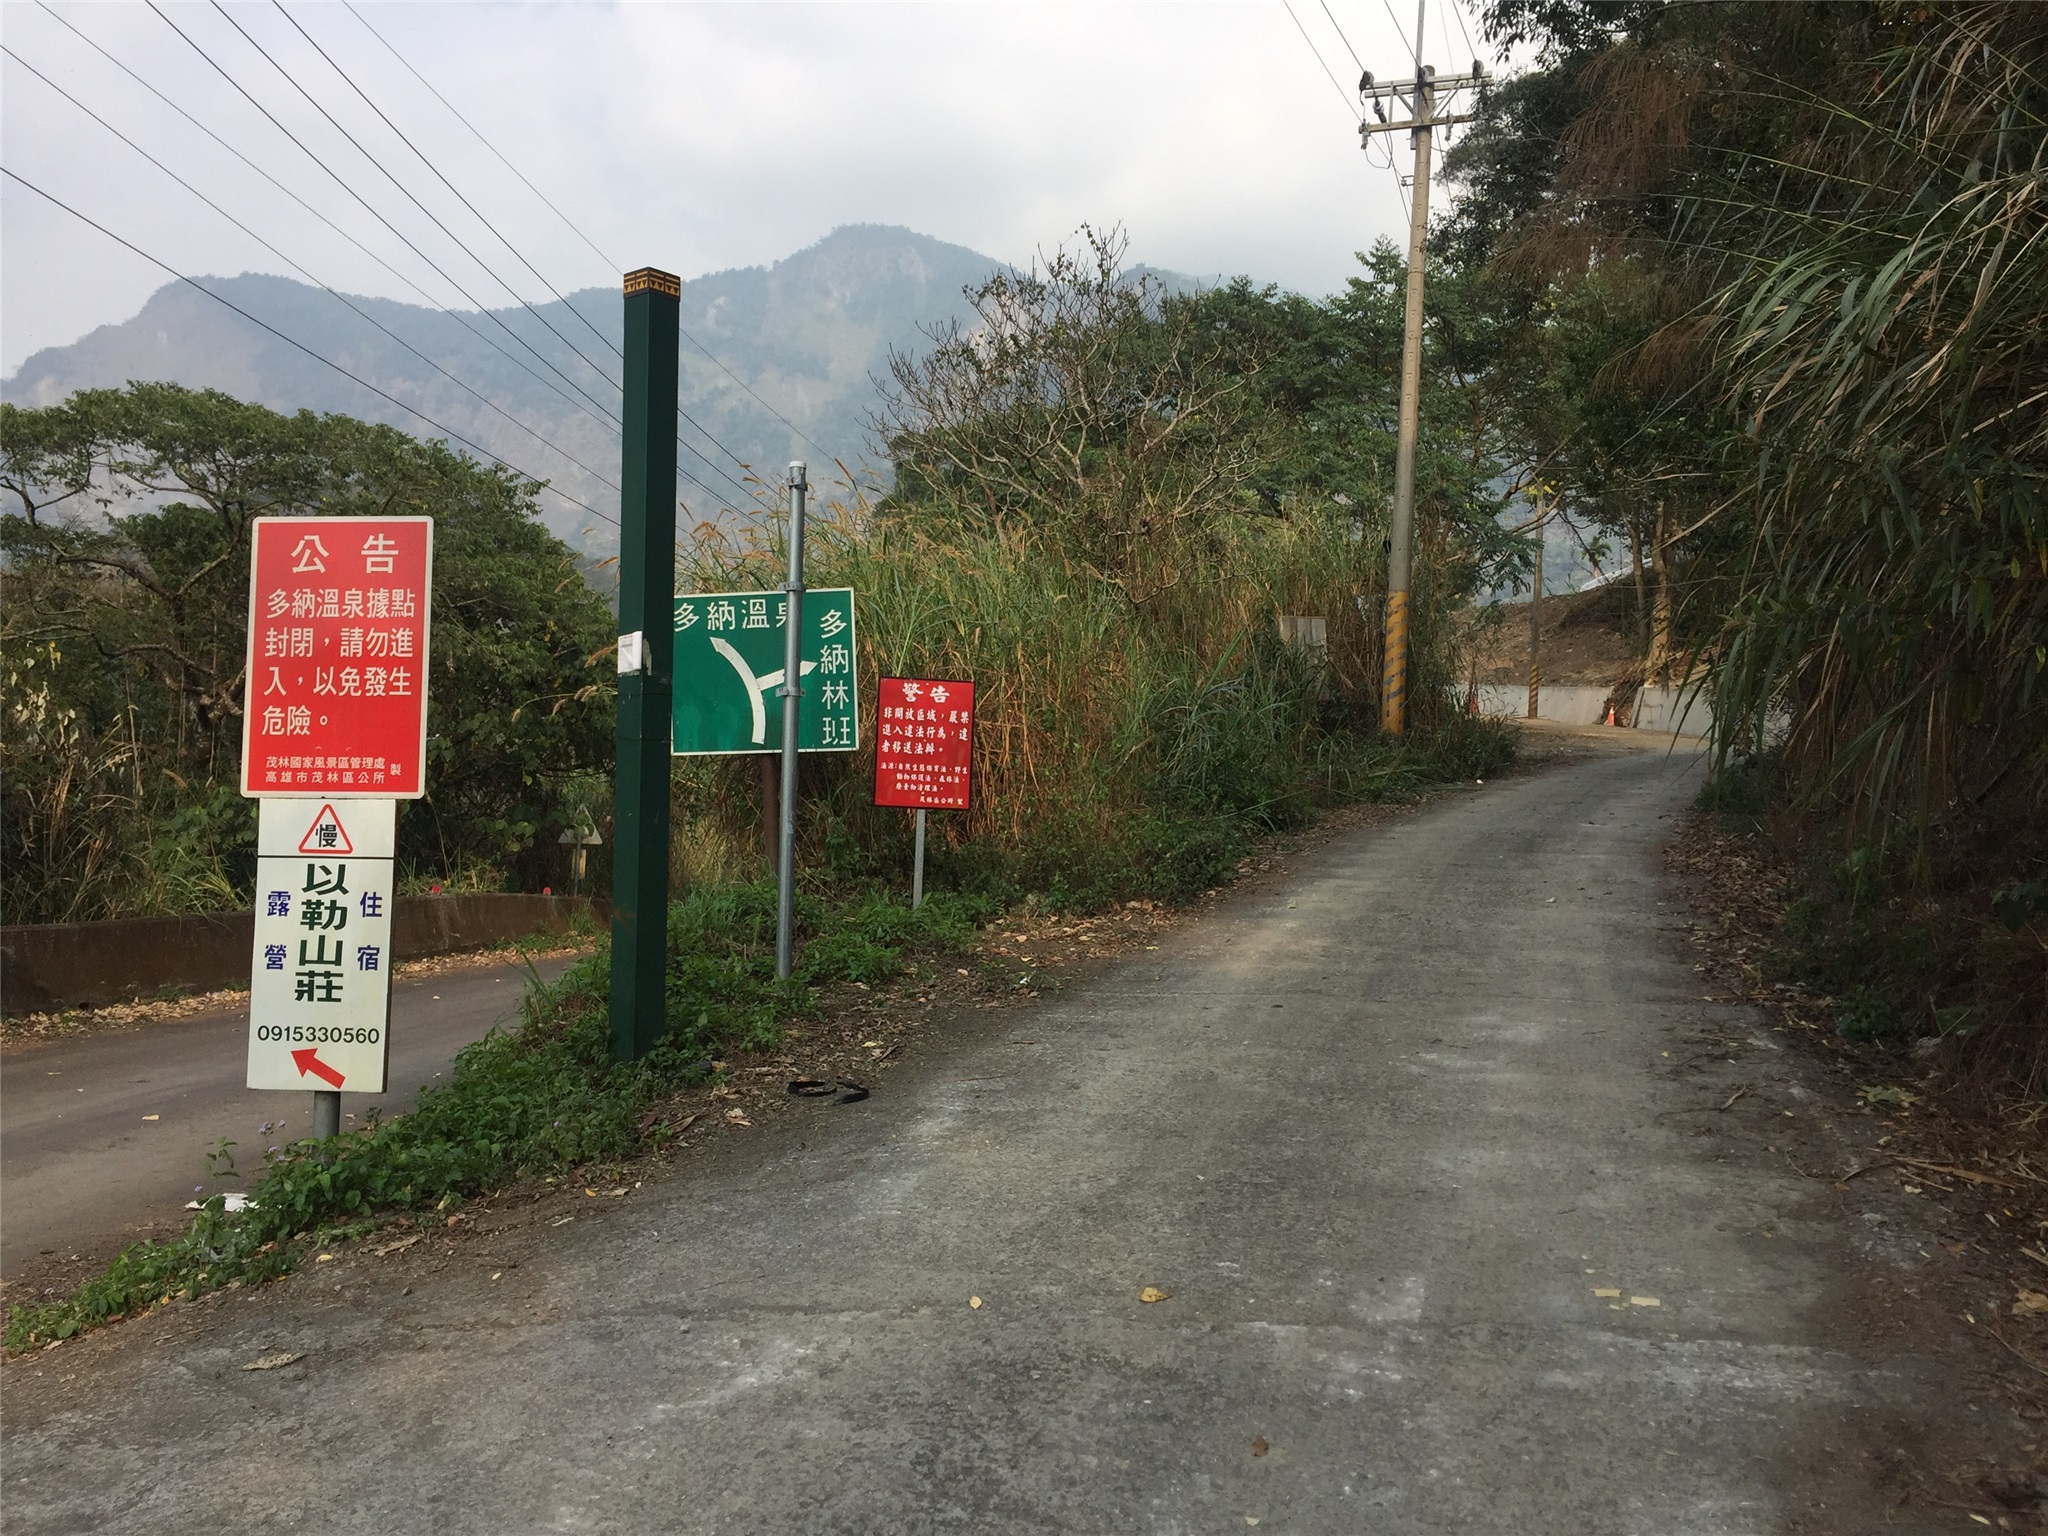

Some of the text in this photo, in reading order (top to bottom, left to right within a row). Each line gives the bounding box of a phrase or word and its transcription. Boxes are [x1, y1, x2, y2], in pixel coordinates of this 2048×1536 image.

[290, 533, 399, 574] 公告
[265, 588, 416, 619] 多納溫泉據點
[264, 627, 414, 658] 封閉，請勿進
[263, 666, 412, 697] 入，以免發生
[819, 608, 851, 746] 多納林班
[901, 682, 951, 704] 警告
[261, 705, 328, 737] 危險。
[265, 755, 402, 776] 茂林國家風景區管理處 製
[265, 771, 385, 784] 高雄市茂林區公所
[315, 823, 338, 848] 慢
[264, 890, 292, 970] 露營
[294, 863, 350, 1003] 以勒山莊
[357, 891, 383, 971] 住宿
[257, 1025, 380, 1044] 0915330560
